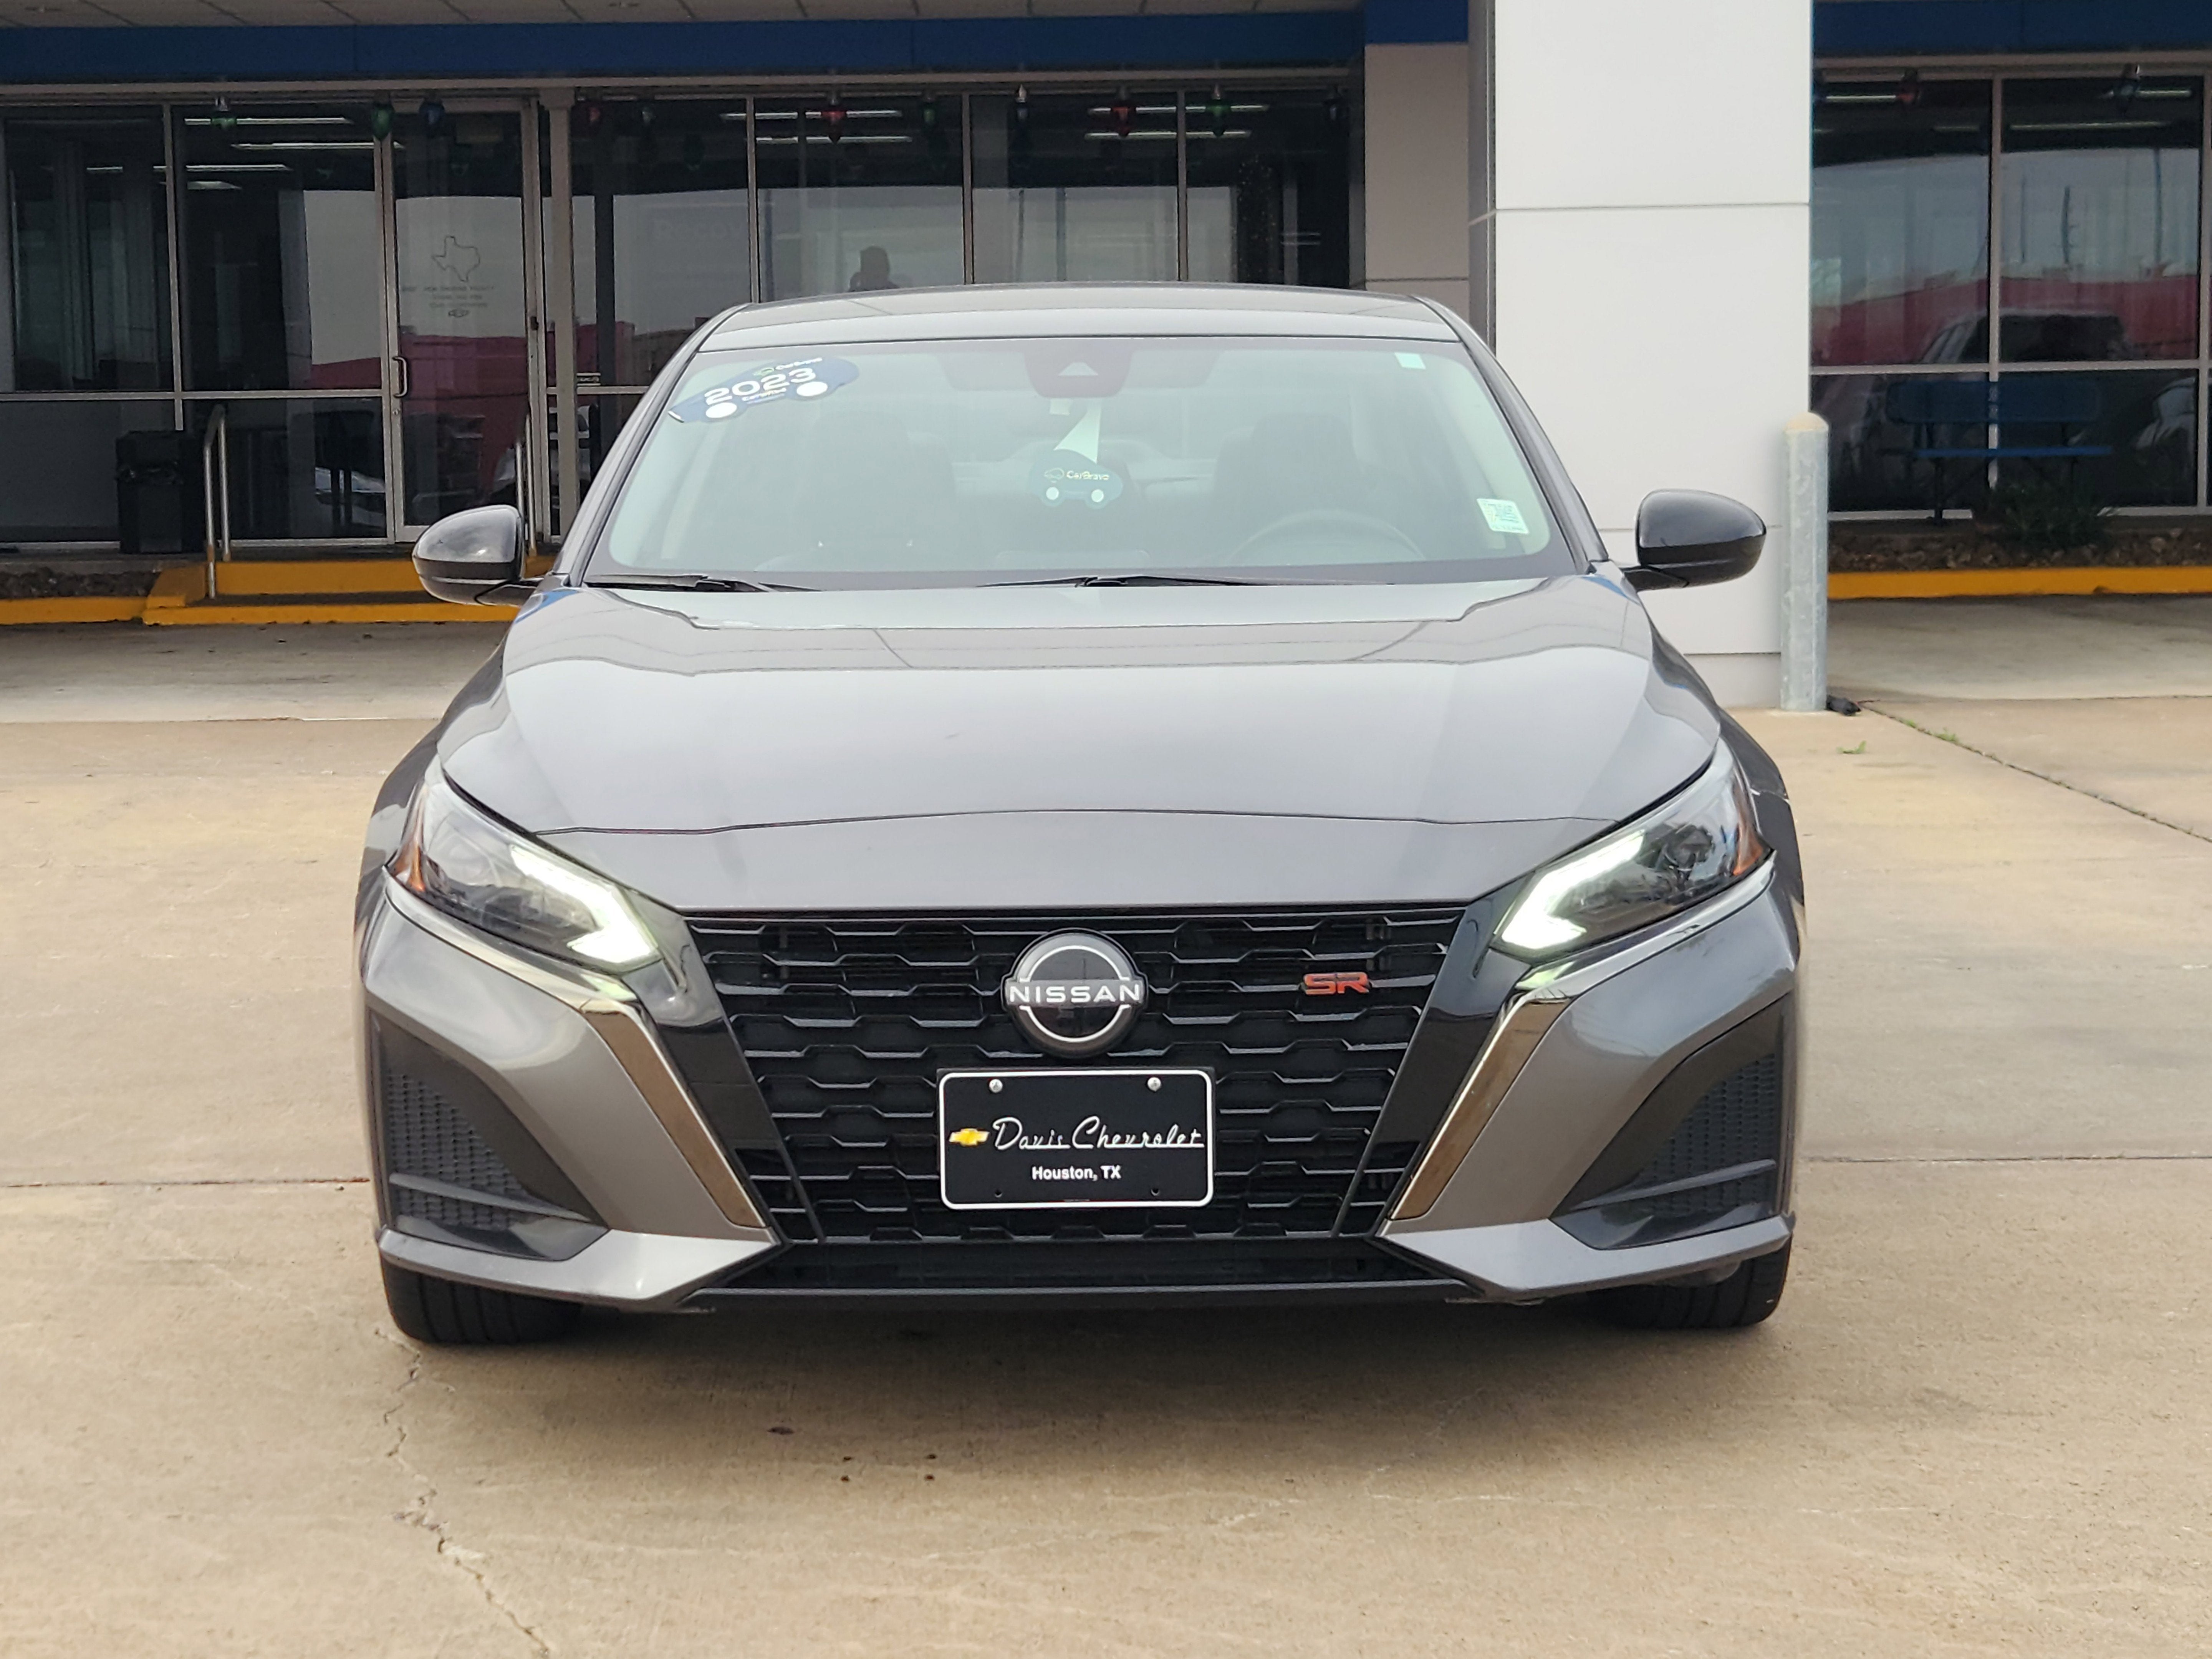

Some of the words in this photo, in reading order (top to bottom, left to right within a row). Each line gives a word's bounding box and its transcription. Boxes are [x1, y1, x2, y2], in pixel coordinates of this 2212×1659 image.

[704, 368, 816, 405] 2023
[1010, 984, 1140, 1003] NISSAN
[1303, 972, 1369, 995] SR
[992, 1116, 1071, 1150] Davis
[1072, 1115, 1205, 1149] Chevrolet
[1031, 1166, 1098, 1181] Houston,
[1100, 1165, 1122, 1180] TX
